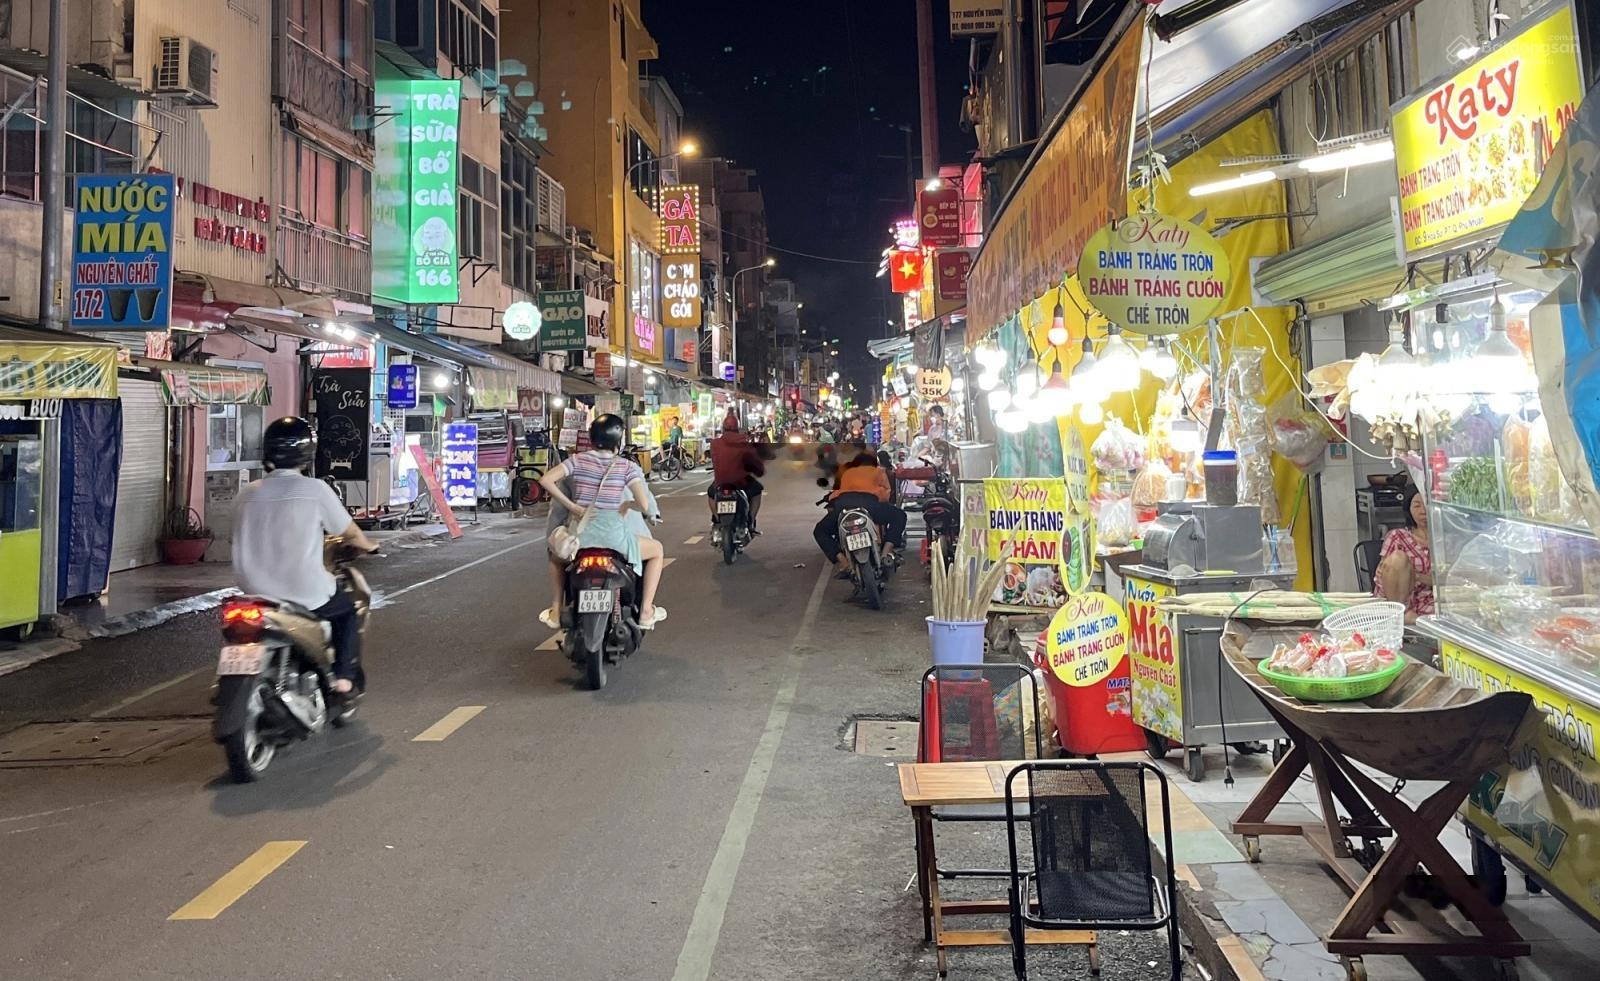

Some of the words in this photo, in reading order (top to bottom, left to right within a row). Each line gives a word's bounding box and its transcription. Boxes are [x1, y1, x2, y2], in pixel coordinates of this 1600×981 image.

[413, 87, 458, 111] TRÀ
[1425, 60, 1519, 145] Katy
[411, 120, 457, 142] SỮA
[419, 151, 452, 174] BỐ
[80, 179, 168, 214] NƯỚC
[415, 182, 454, 206] GIÀ
[664, 193, 695, 220] GÀ
[81, 215, 167, 254] MÍA
[665, 225, 694, 247] TA
[1120, 214, 1190, 249] Katy
[77, 257, 124, 285] NGUYÊN
[127, 254, 159, 284] CHẤT
[1099, 248, 1132, 269] BÁNH
[1137, 249, 1177, 271] TRÁNG
[1182, 251, 1213, 275] TRỘN
[416, 269, 452, 287] 166
[664, 279, 698, 299] CHÁO
[1089, 274, 1128, 296] BÁNH
[1134, 275, 1181, 297] TRÁNG
[1187, 275, 1224, 298] CUỐN
[74, 290, 104, 320] 172
[671, 298, 692, 318] GỎI
[1155, 304, 1189, 328] TRỘN
[315, 375, 341, 394] Trà
[921, 388, 943, 396] 35K
[989, 506, 1021, 530] BÁNH
[1024, 507, 1063, 532] TRÁNG
[1542, 703, 1596, 760] TRỘN
